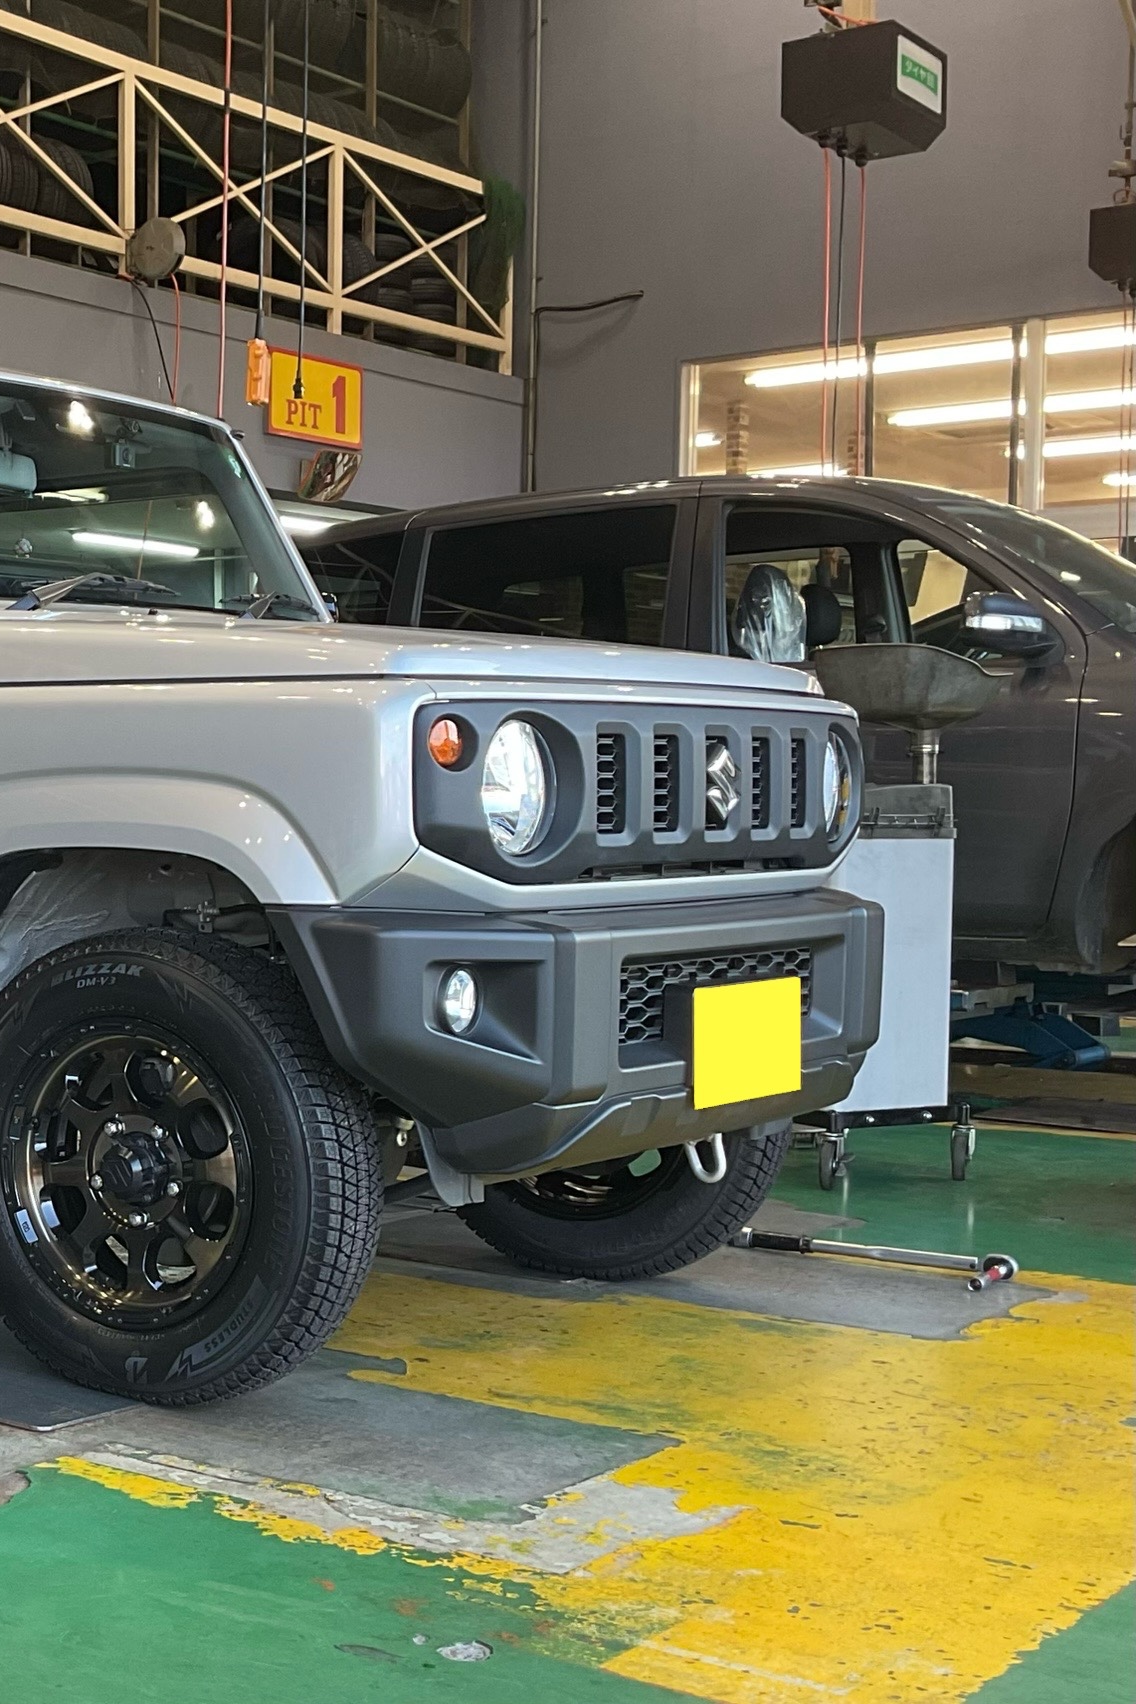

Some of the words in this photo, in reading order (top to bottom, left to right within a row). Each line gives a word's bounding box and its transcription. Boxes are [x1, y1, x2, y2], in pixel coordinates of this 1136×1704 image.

[285, 399, 322, 430] PIT
[332, 375, 346, 435] 1
[51, 962, 145, 988] BLIZZAK
[76, 976, 116, 989] DM-V3
[203, 1298, 255, 1353] STUDLESS
